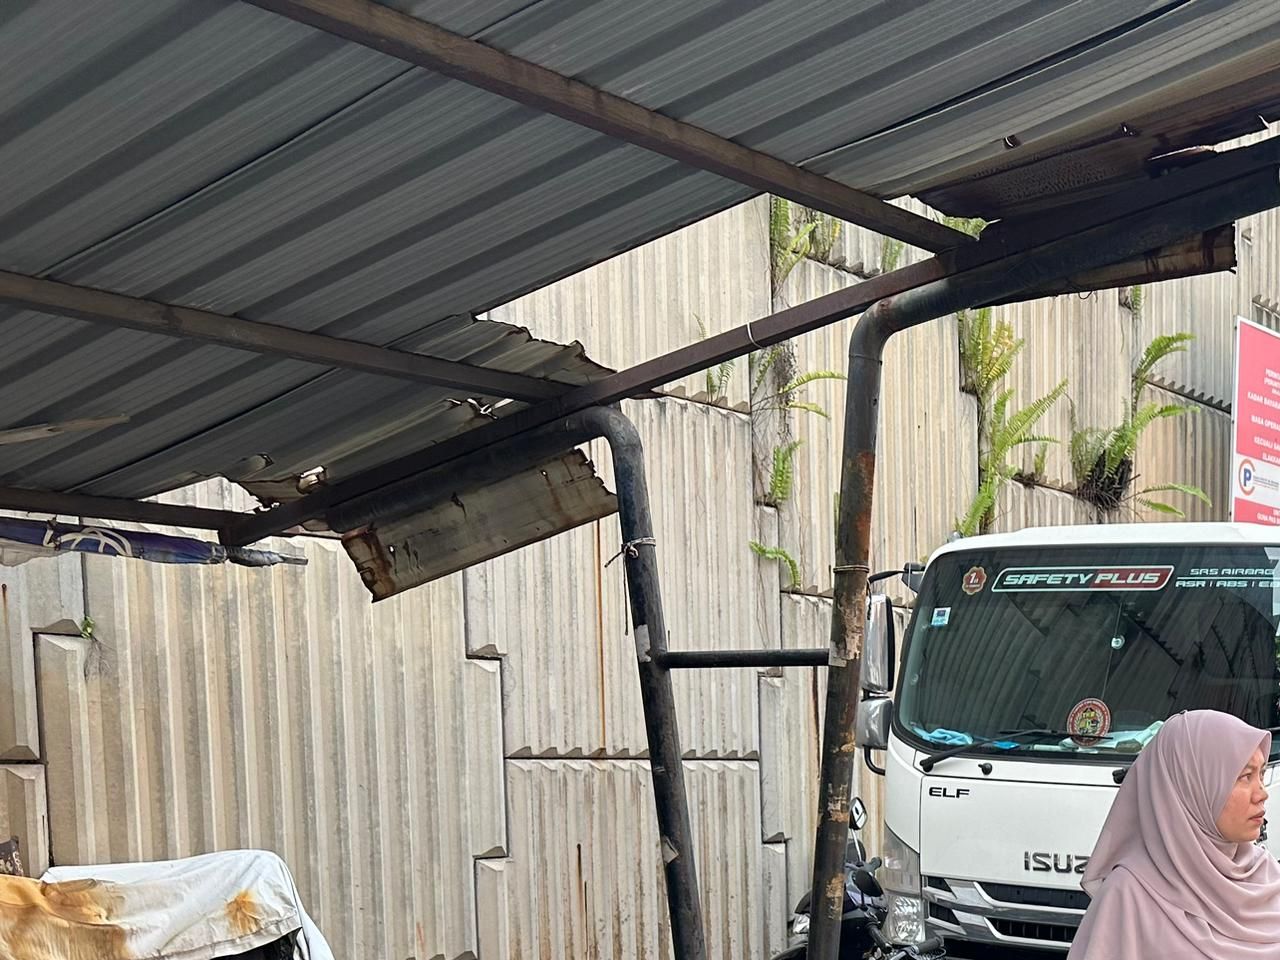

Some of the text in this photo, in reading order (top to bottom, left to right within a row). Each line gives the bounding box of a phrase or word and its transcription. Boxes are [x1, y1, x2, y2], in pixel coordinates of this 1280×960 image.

[1248, 391, 1264, 404] KADAR
[1003, 572, 1160, 585] SAFETY PLUS
[928, 787, 970, 798] ELF
[1024, 851, 1091, 875] ISUZ
